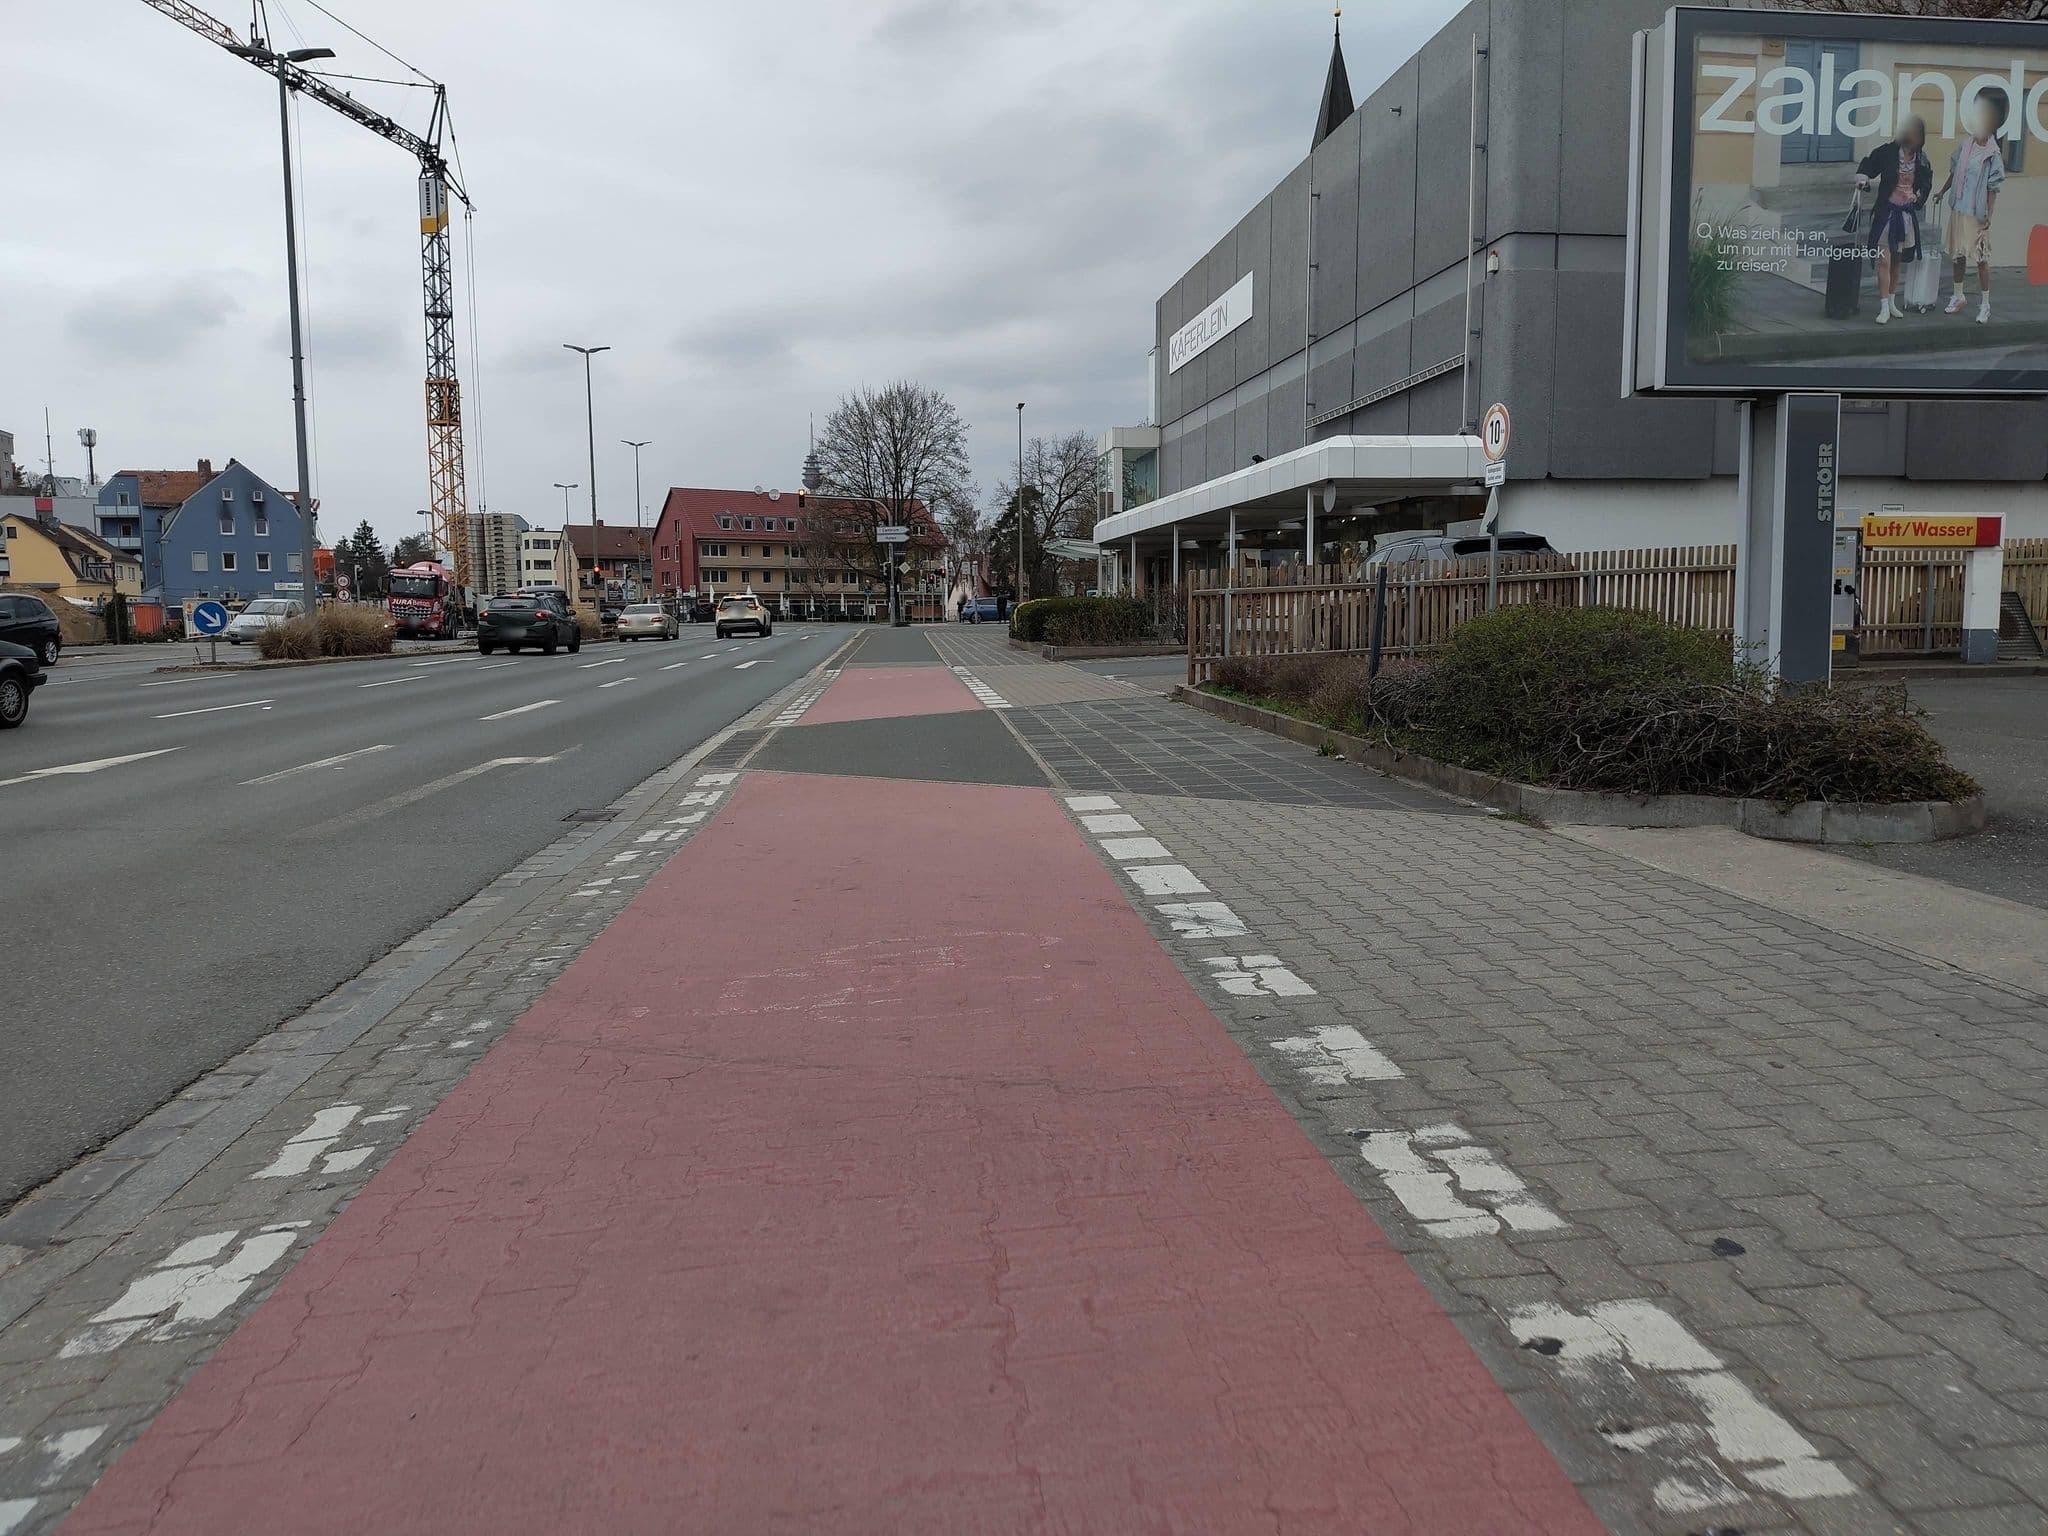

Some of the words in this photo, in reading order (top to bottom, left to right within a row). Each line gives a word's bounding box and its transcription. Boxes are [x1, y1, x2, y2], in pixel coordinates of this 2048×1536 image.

[1718, 225, 1748, 240] Was
[1751, 227, 1781, 241] zieh
[1783, 228, 1804, 241] ich
[1808, 231, 1829, 243] an,
[1717, 245, 1739, 255] um
[1742, 246, 1766, 256] nur
[1770, 245, 1792, 257] mit
[1796, 244, 1885, 261] Handgepäck
[1716, 261, 1733, 271] zu
[1736, 259, 1787, 272] reisen?
[1171, 300, 1228, 366] KÄFERLEIN
[1490, 420, 1501, 444] 10
[1817, 443, 1833, 522] STRÖER
[1866, 521, 1974, 537] Luft/Wasser
